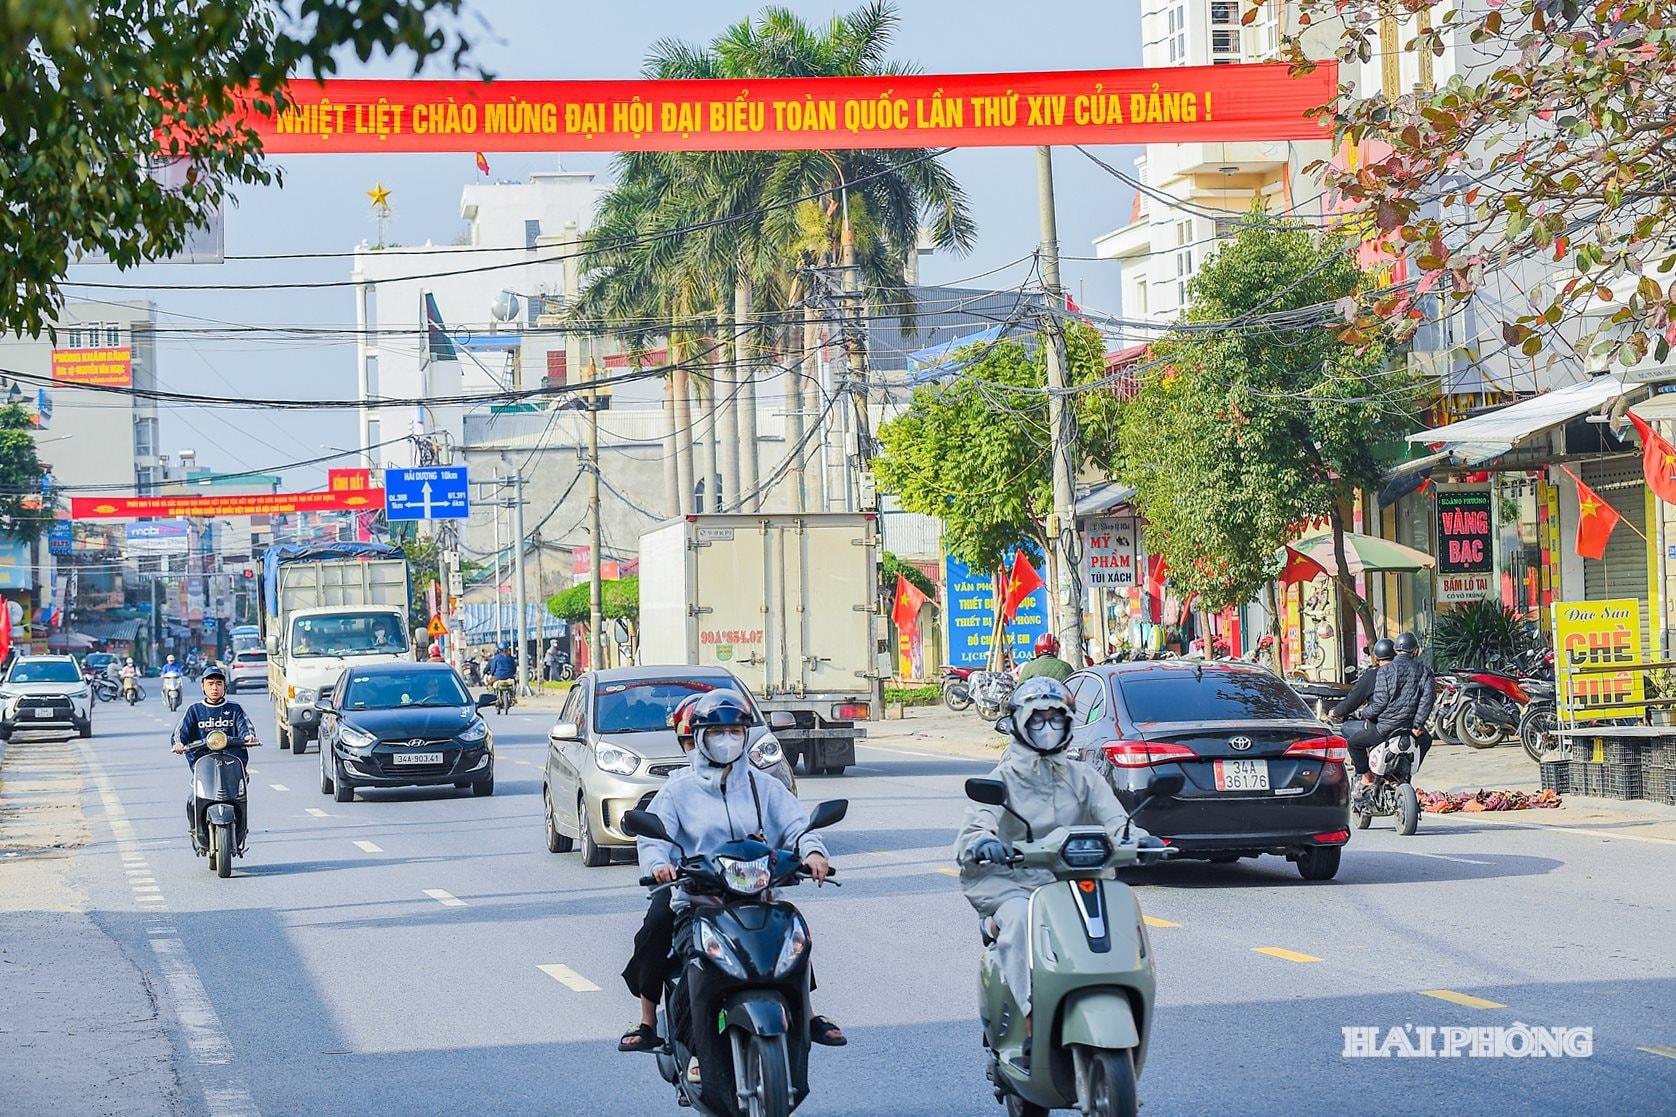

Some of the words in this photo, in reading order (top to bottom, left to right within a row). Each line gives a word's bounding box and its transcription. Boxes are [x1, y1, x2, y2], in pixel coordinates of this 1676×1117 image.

[277, 97, 347, 140] NHIỆT
[355, 97, 406, 140] LIỆT
[412, 96, 477, 134] CHÀO
[485, 96, 557, 133] MỪNG
[564, 101, 605, 140] ĐẠI
[613, 96, 652, 139] HỘI
[661, 101, 700, 139] ĐẠI
[709, 89, 761, 132] BIỂU
[773, 94, 837, 131] TOÀN
[844, 89, 909, 133] QUỐC
[916, 88, 963, 130] LẦN
[971, 88, 1020, 127] THỨ
[1027, 95, 1067, 126] XIV
[1074, 83, 1122, 124] CỦA
[1130, 82, 1197, 123] ĐẢNG
[1206, 91, 1213, 121] !
[1441, 507, 1489, 535] VÀNG
[1090, 533, 1111, 549] MỸ
[1091, 549, 1130, 568] PHẨM
[1448, 539, 1484, 568] BẠC
[1091, 571, 1105, 583] TÚI
[1108, 571, 1132, 583] XÁCH
[1476, 579, 1488, 590] TAI
[1565, 625, 1633, 665] CHÈ
[198, 716, 234, 728] adidas
[1233, 761, 1257, 774] 34A
